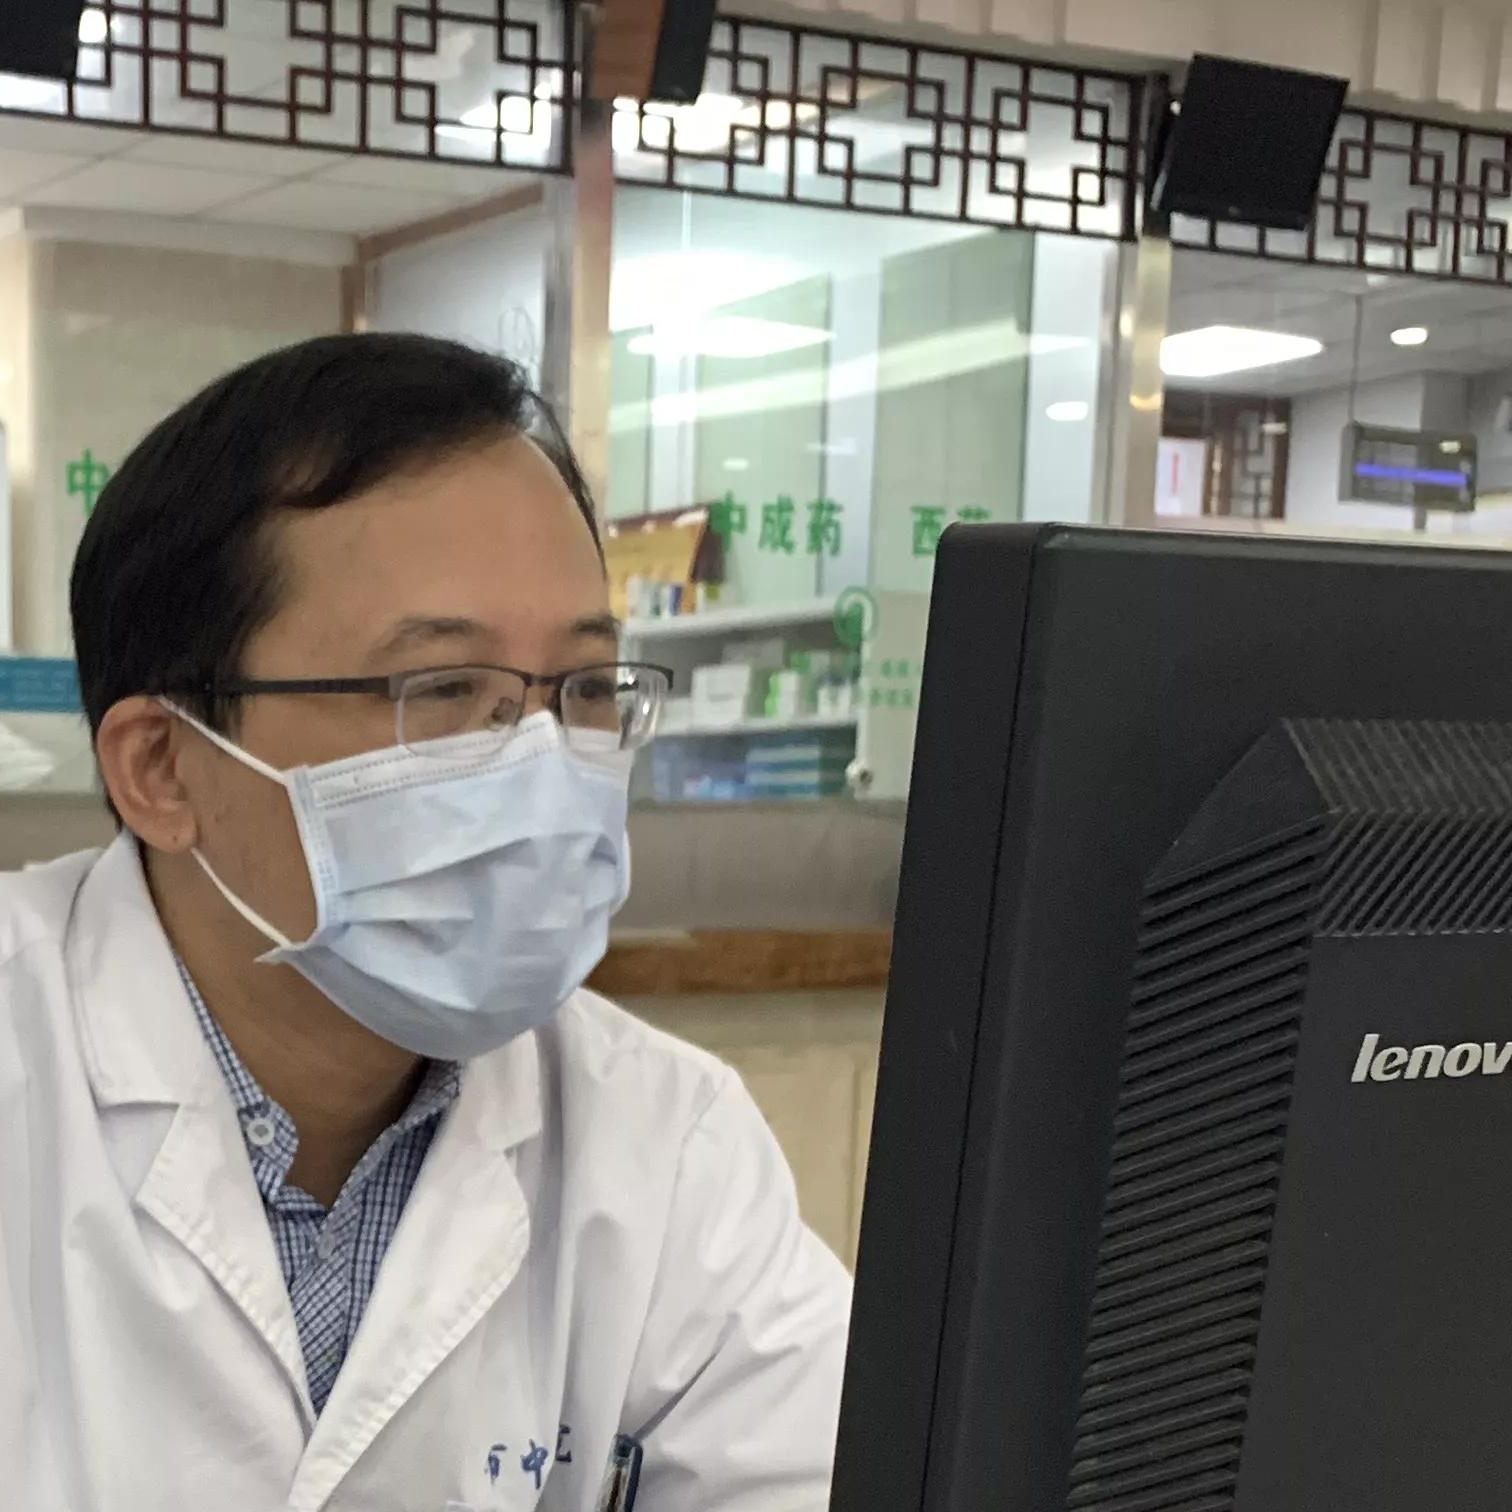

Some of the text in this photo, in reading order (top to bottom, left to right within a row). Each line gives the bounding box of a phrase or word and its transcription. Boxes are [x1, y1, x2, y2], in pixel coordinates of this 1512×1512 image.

[66, 447, 110, 519] 中
[711, 491, 992, 558] 中成药 西
[1350, 1033, 1512, 1083] lenov
